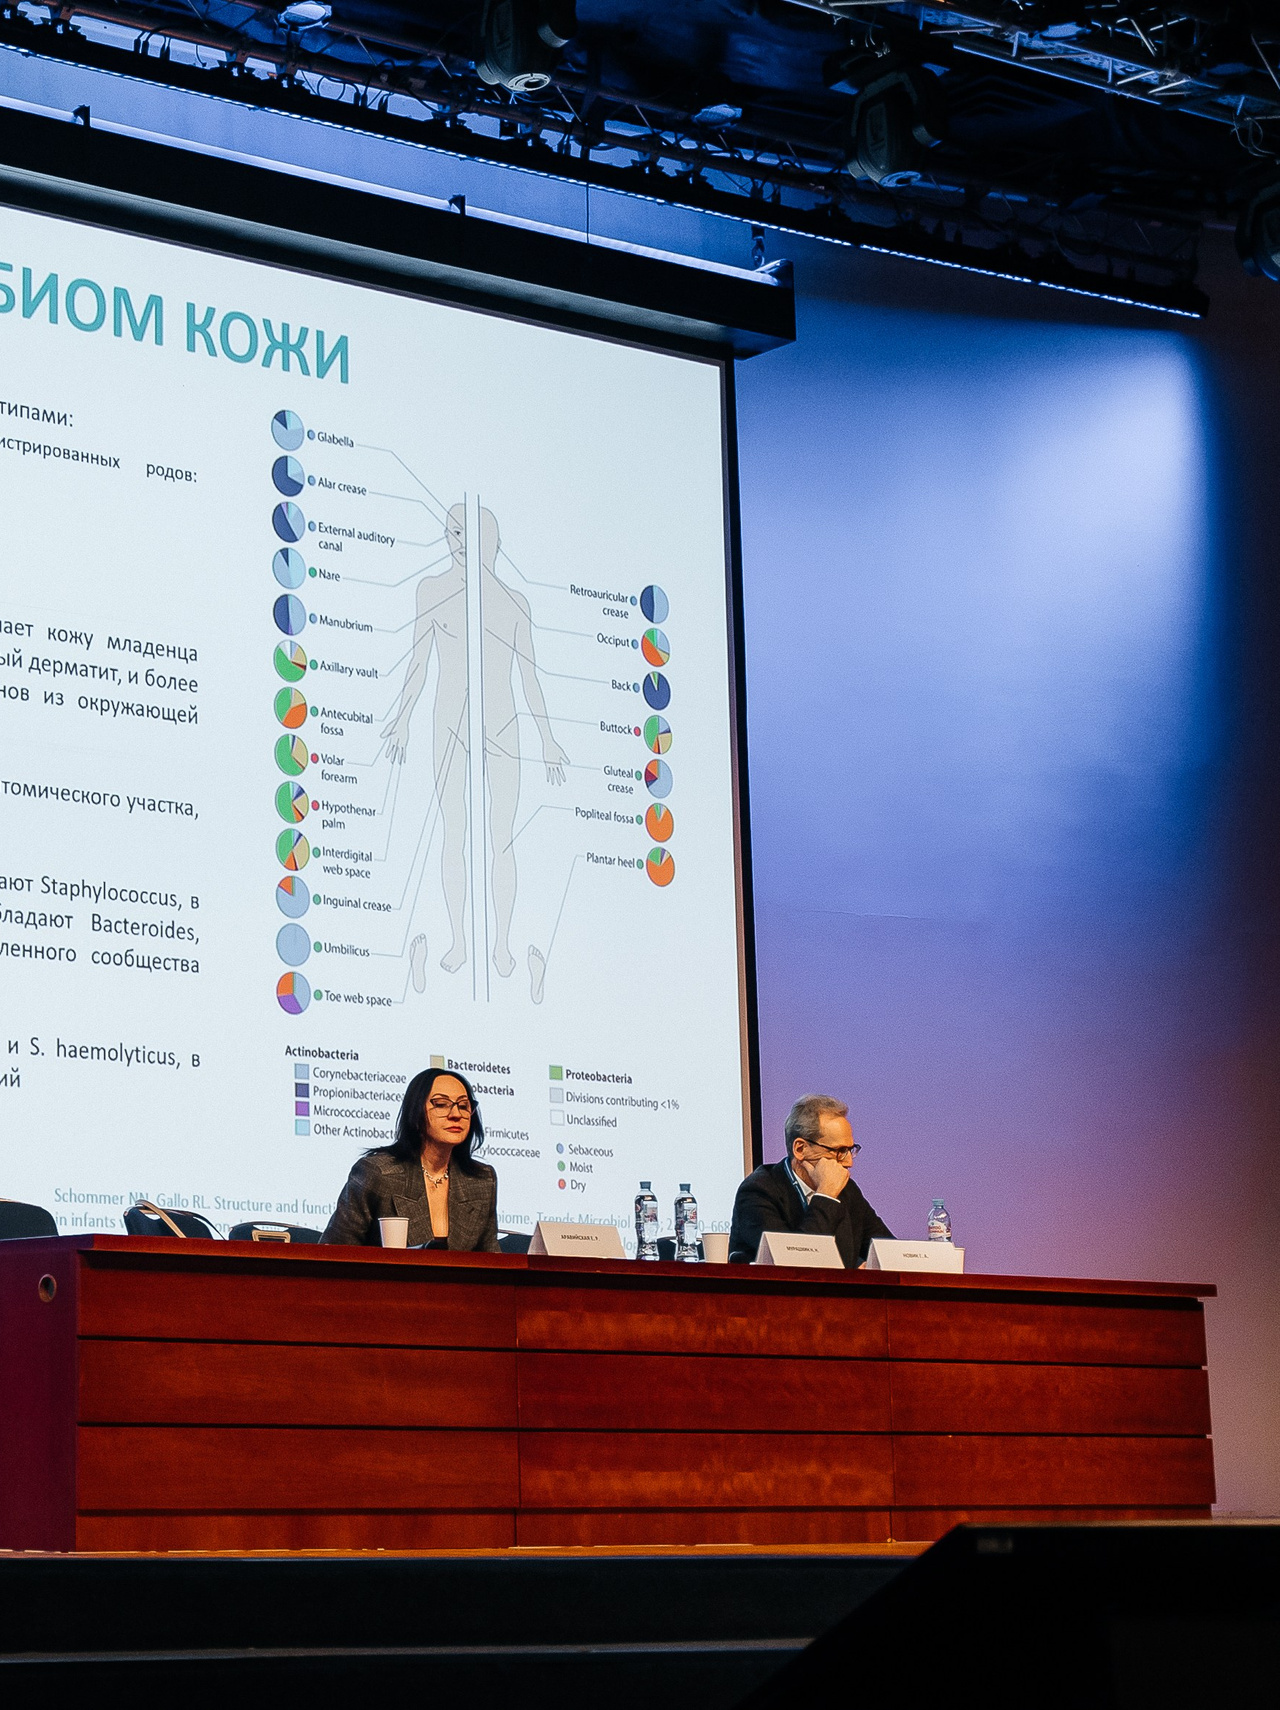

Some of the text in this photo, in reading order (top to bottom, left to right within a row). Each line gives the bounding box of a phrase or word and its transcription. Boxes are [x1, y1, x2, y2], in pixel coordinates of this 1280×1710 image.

[185, 301, 349, 384] КОЖИ
[317, 431, 354, 448] Glabella
[146, 463, 197, 483] родов:
[317, 476, 366, 496] Alar crease
[318, 521, 395, 547] External auditory
[318, 540, 342, 552] canal
[318, 567, 340, 582] Nare
[569, 583, 628, 603] Retroauricular
[602, 607, 628, 619] crease
[319, 614, 372, 632] Manubrium
[47, 626, 93, 651] кожу
[106, 635, 197, 664] младенца
[596, 632, 629, 648] Occiput
[27, 656, 121, 685] дерматит,
[144, 667, 198, 693] более
[319, 659, 378, 679] Axillary vault
[611, 678, 631, 691] Back
[43, 690, 64, 706] из
[77, 695, 198, 725] окружающей
[320, 706, 373, 724] Antecubital
[320, 722, 343, 736] fossa
[599, 720, 632, 735] Buttock
[320, 752, 344, 765] Volar
[321, 768, 357, 784] forearm
[603, 765, 633, 778] Gluteal
[607, 783, 633, 794] crease
[126, 795, 198, 820] участка,
[321, 799, 376, 816] Hypothenar
[574, 806, 634, 824] Popliteal fossa
[321, 817, 345, 829] palm
[322, 845, 372, 863] Interdigital
[586, 851, 635, 868] Plantar heel
[322, 863, 370, 878] web space
[40, 875, 182, 911] Staphylococcus,
[323, 894, 392, 912] Inguinal crease
[91, 912, 199, 945] Bacteroides,
[323, 942, 369, 957] Umbilicus
[90, 948, 199, 973] сообщества
[324, 989, 392, 1007] Toe web space
[29, 1036, 44, 1056] S.
[56, 1037, 180, 1069] haemolyticus,
[284, 1044, 359, 1061] Actinobacteria
[312, 1066, 406, 1083] Corynebacteriaceae
[447, 1058, 510, 1074] Bacteroidetes
[565, 1068, 632, 1084] Proteobacteria
[565, 1091, 680, 1110] Divisions contributing <1%
[313, 1104, 389, 1119] Micrococciaceae
[566, 1113, 617, 1127] Unclassified
[313, 1123, 340, 1136] Other
[484, 1126, 530, 1140] Firmicutes
[568, 1143, 613, 1157] Sebaceous
[569, 1161, 593, 1173] Moist
[570, 1178, 586, 1192] Dry
[54, 1187, 299, 1213] Schommer Gallo Structure and
[71, 1211, 116, 1229] infants
